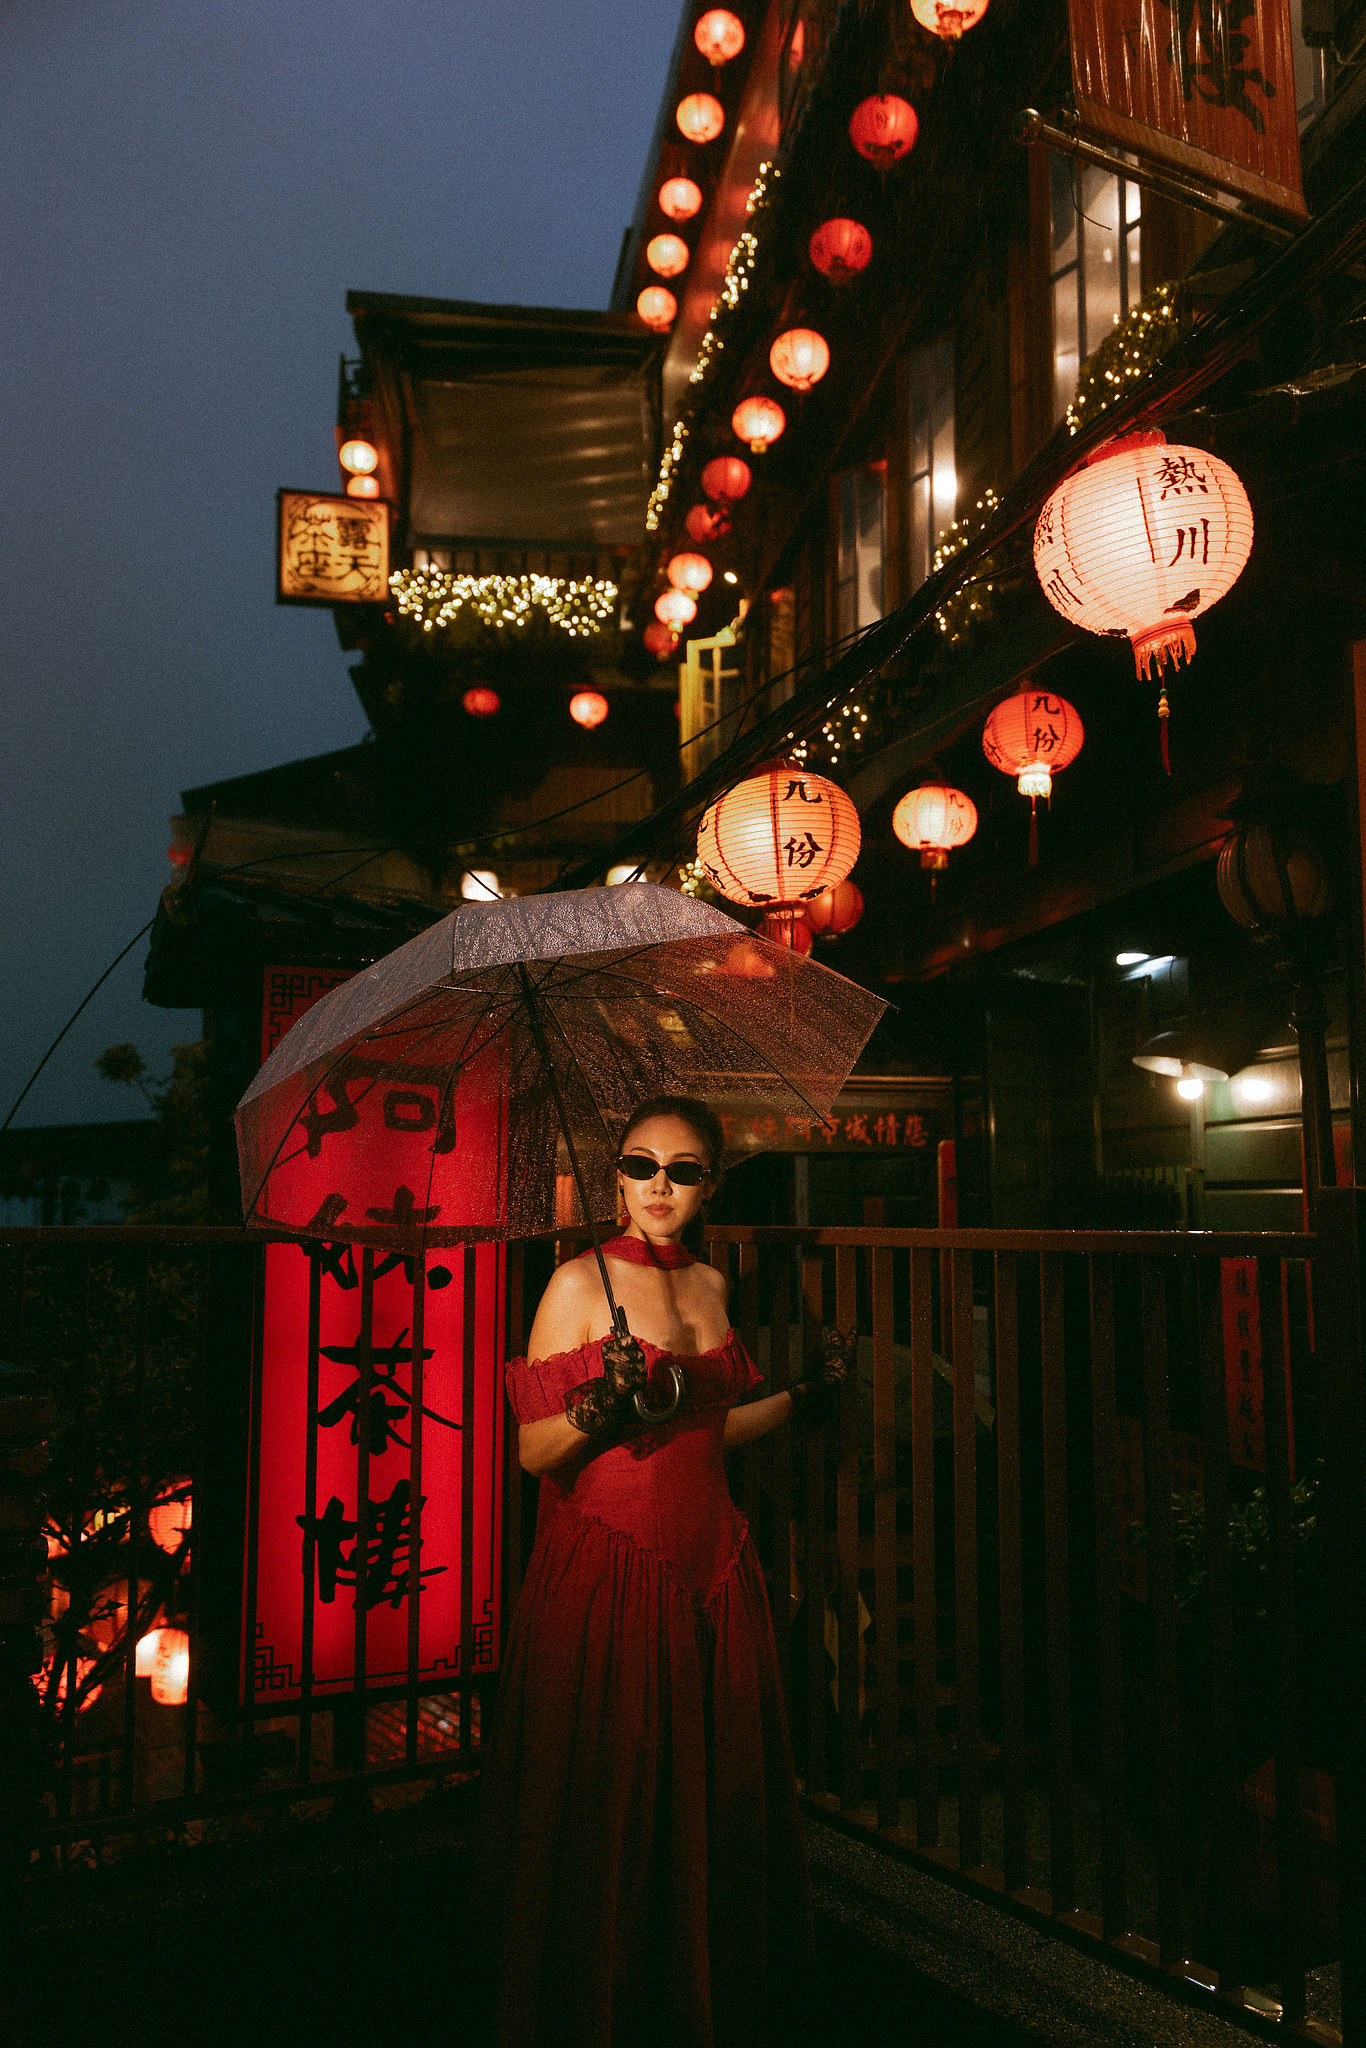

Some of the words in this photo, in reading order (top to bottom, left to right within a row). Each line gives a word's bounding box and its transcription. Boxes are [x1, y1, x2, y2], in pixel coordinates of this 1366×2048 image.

[288, 513, 334, 581] 茶座
[337, 515, 382, 582] 露天
[1155, 455, 1209, 567] 熱川
[1032, 695, 1061, 753] 九份
[782, 780, 824, 868] 九份
[295, 1052, 465, 1613] 阿妹茶樓
